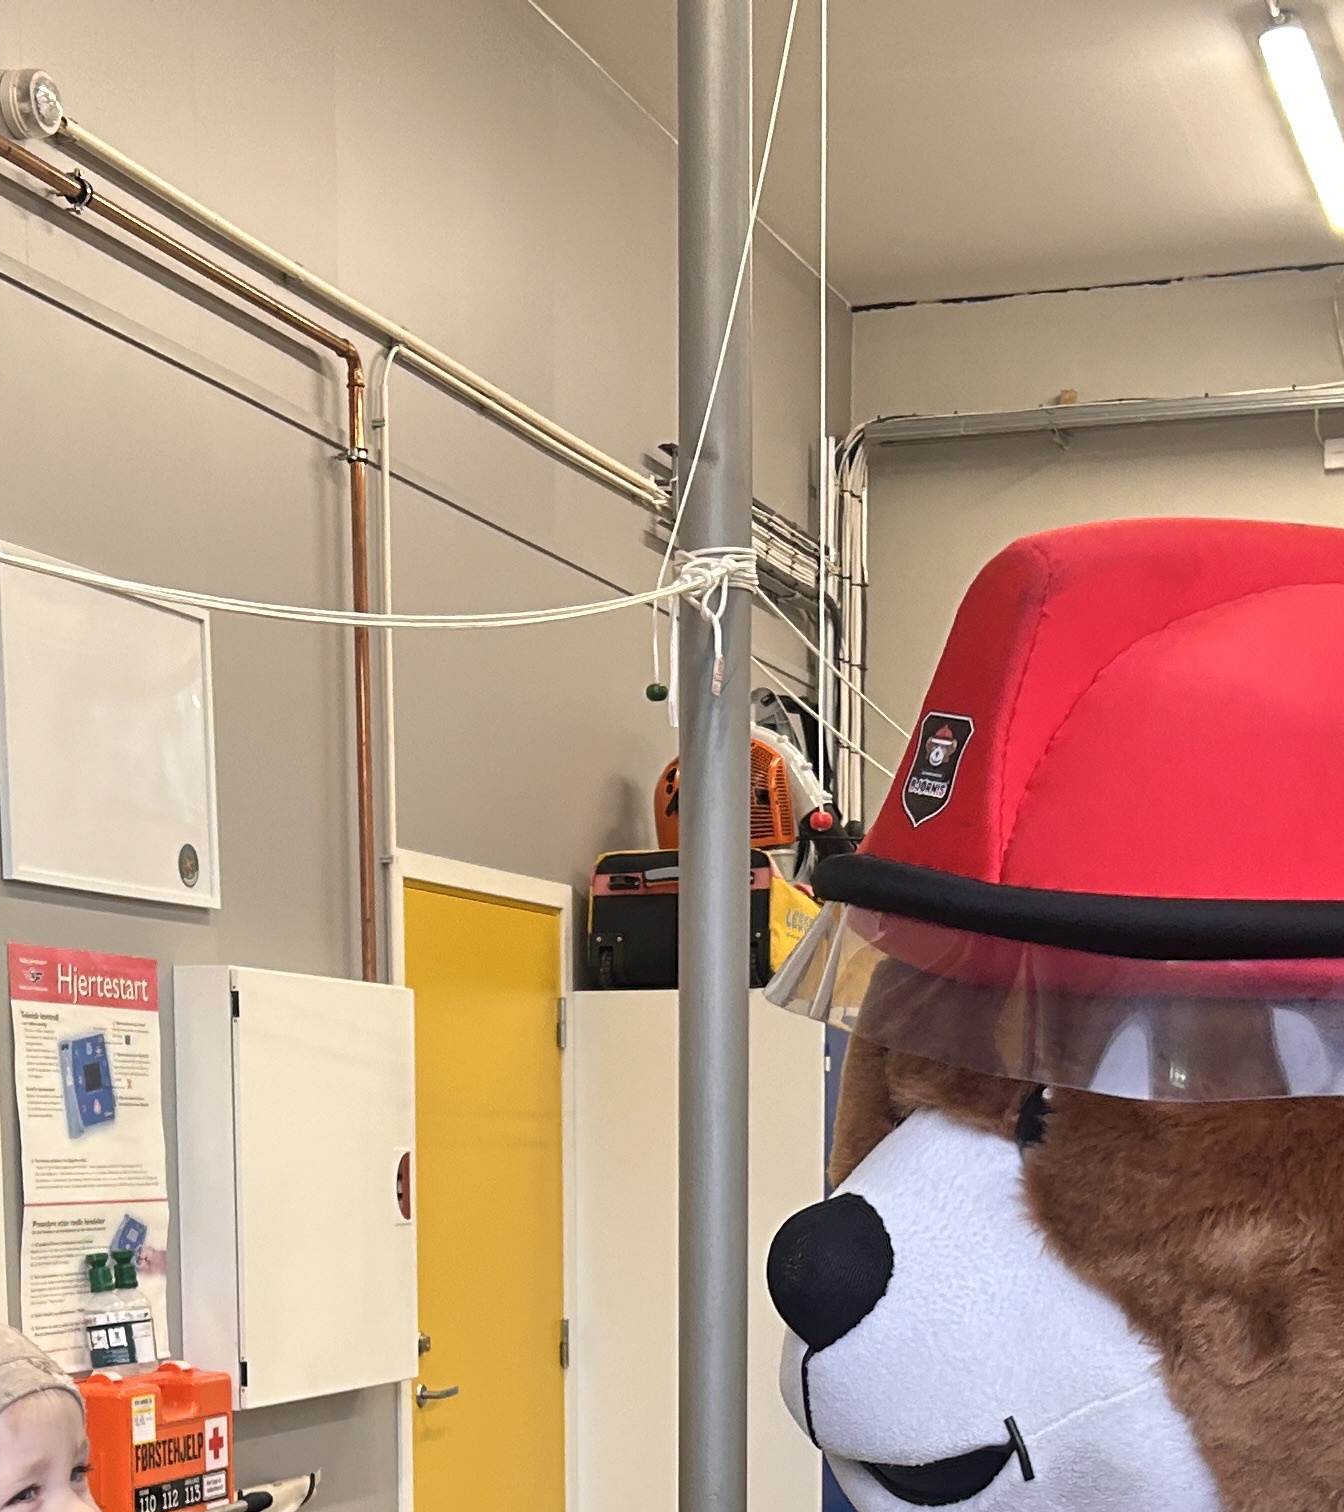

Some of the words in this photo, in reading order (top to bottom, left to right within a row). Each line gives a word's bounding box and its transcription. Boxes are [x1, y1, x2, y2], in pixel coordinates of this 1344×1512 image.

[57, 963, 149, 1004] Hjertestart
[135, 1432, 204, 1473] FØRSTEHJELP
[162, 1488, 179, 1510] 112
[184, 1484, 201, 1504] 113
